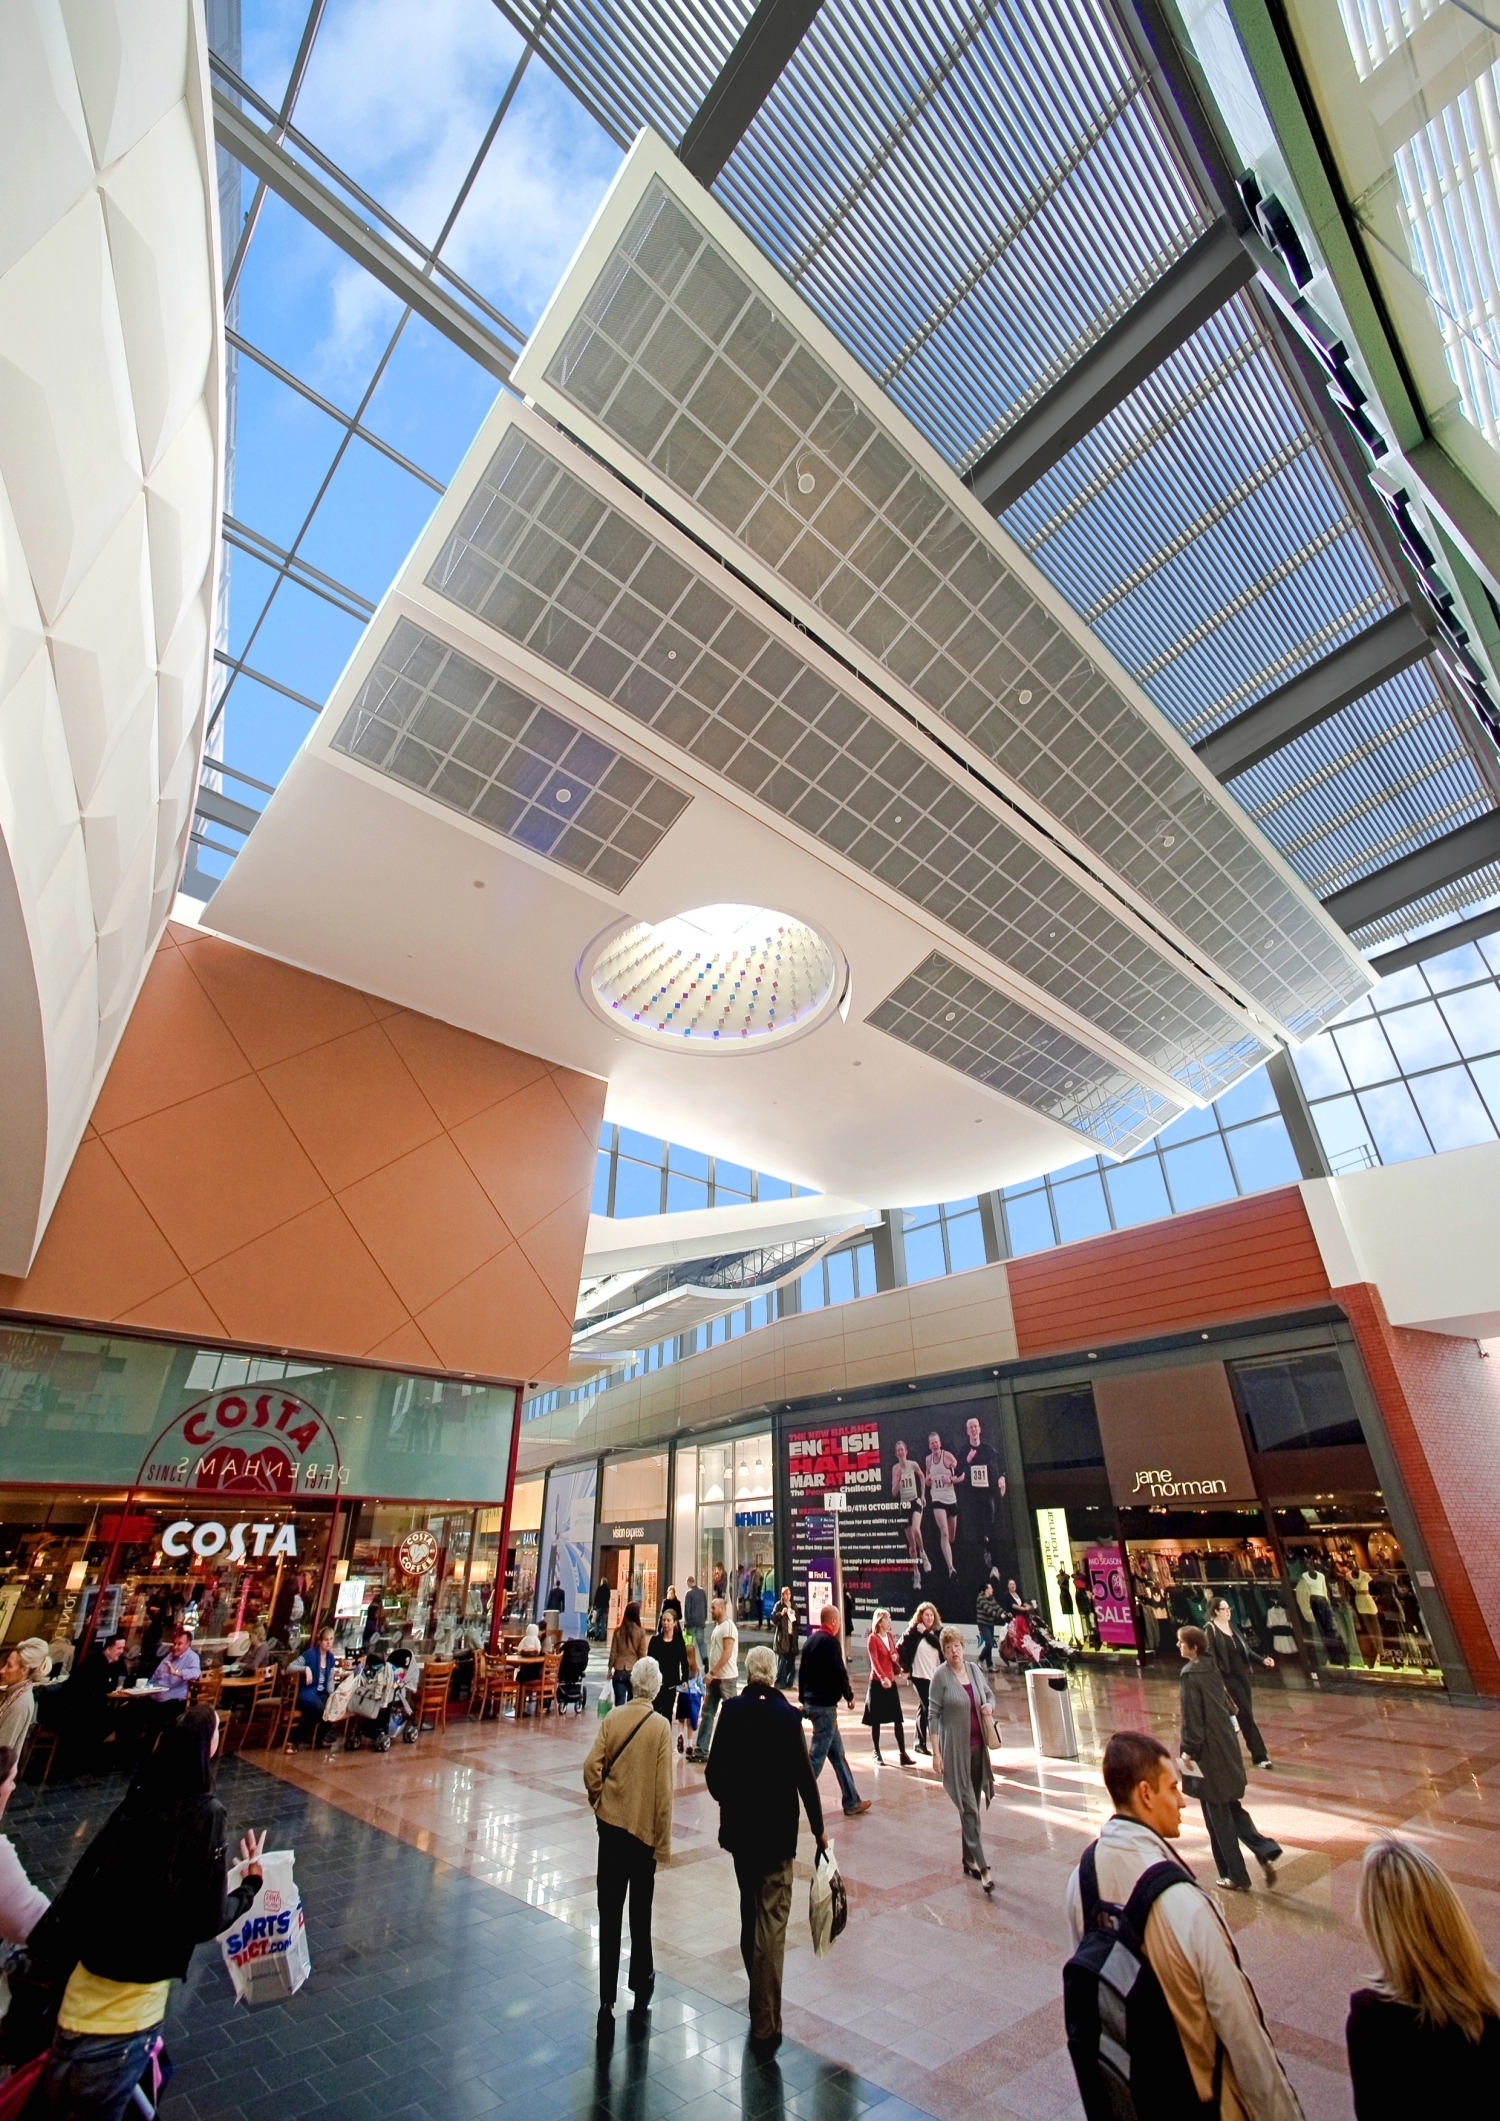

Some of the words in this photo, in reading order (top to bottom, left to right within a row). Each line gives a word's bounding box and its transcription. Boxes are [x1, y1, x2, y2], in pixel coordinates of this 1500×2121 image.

[183, 1394, 320, 1454] COSTA
[789, 1432, 806, 1441] THE
[808, 1429, 830, 1438] NEW
[831, 1423, 877, 1436] BALANCE
[789, 1431, 880, 1456] ENGLISH
[789, 1451, 880, 1474] HALF
[147, 1464, 184, 1483] SINCE
[304, 1474, 330, 1489] 1971
[789, 1468, 882, 1489] MARATHON
[973, 1470, 986, 1480] 391
[1132, 1469, 1173, 1493] jane
[790, 1489, 804, 1497] The
[840, 1484, 882, 1493] Challenge
[1150, 1479, 1227, 1497] norman
[868, 1502, 899, 1512] OCTOBER
[161, 1521, 297, 1562] COSTA
[407, 1532, 433, 1546] COSTA
[612, 1526, 625, 1538] vision
[626, 1527, 645, 1540] express
[402, 1556, 433, 1573] COFFEE
[1088, 1557, 1100, 1565] MID
[1100, 1557, 1122, 1565] SEASON
[1095, 1606, 1133, 1624] SALE
